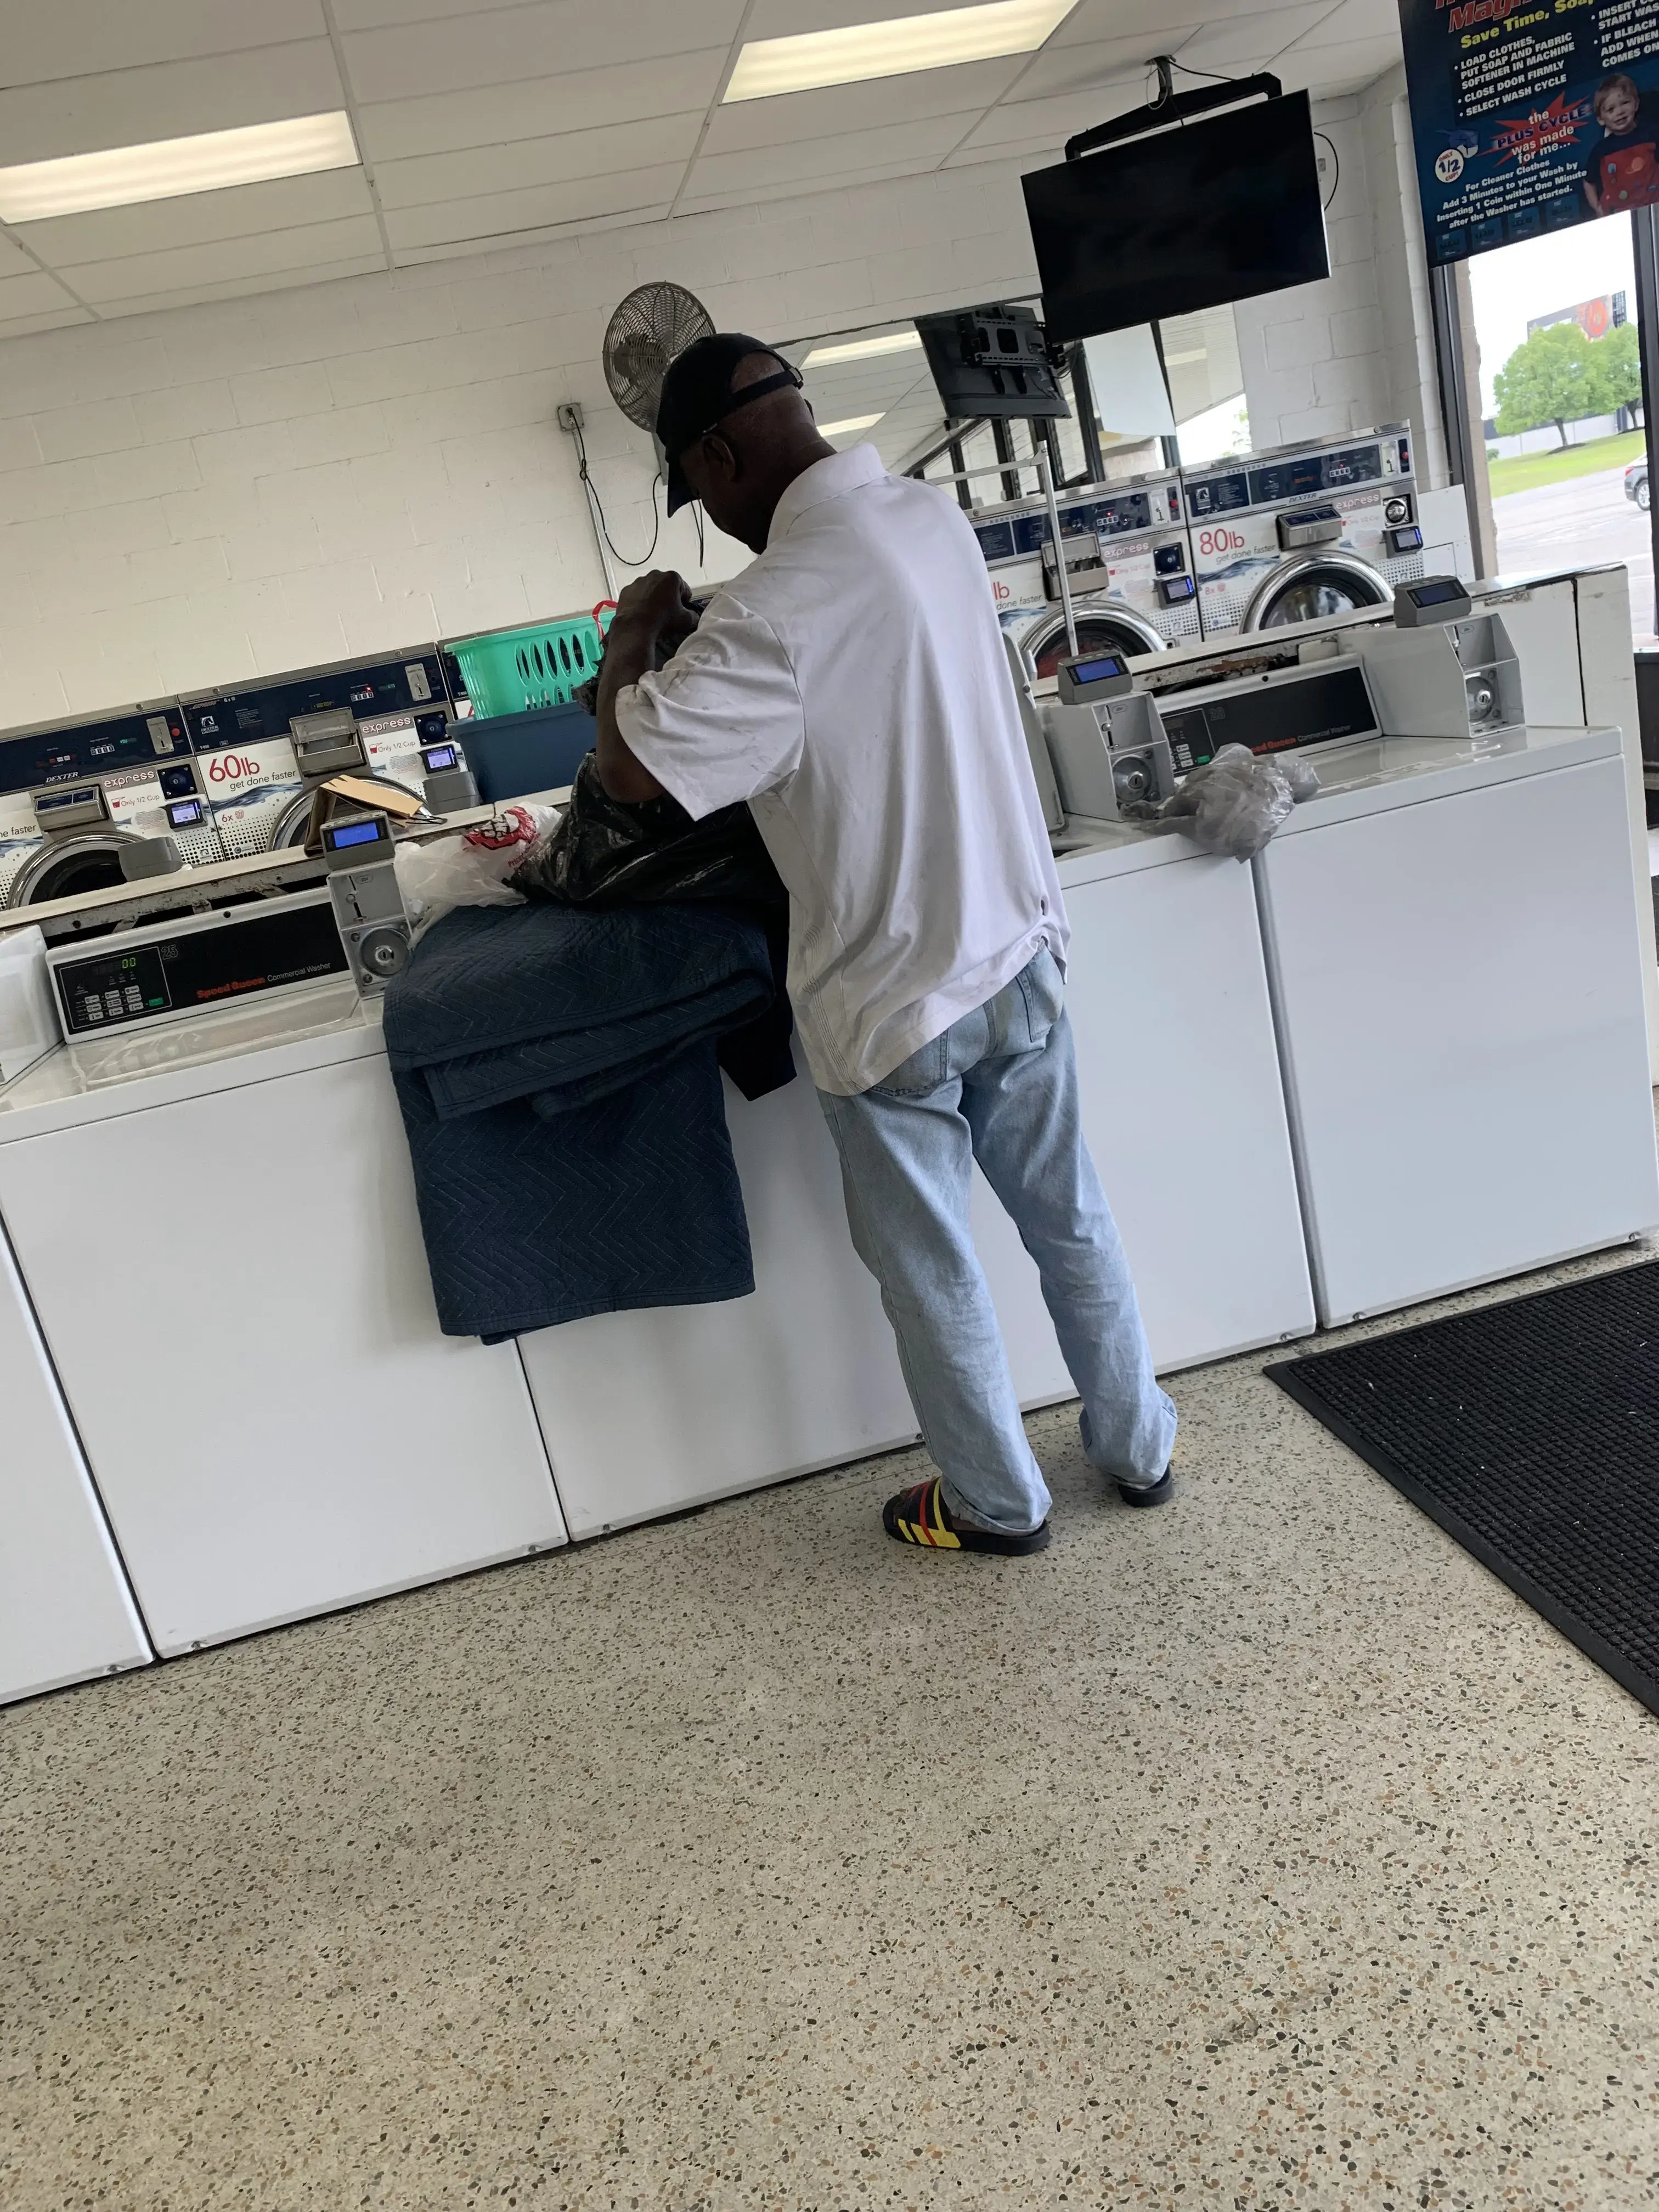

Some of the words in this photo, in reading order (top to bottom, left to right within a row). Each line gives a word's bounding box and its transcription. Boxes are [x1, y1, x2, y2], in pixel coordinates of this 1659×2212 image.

[1599, 0, 1636, 19] INSERT
[1599, 11, 1632, 30] START
[1634, 2, 1659, 18] WAS
[1460, 27, 1499, 48] Save
[1503, 9, 1550, 32] Time,
[1601, 33, 1611, 44] IF
[1614, 18, 1657, 40] BLEACH
[1460, 53, 1486, 70] LOAD
[1489, 36, 1536, 59] CLOTHES,
[1601, 42, 1624, 57] ADD
[1626, 29, 1659, 48] WHEN
[1602, 48, 1641, 67] COMES
[1644, 41, 1659, 54] ON
[1460, 66, 1479, 80] PUT
[1482, 55, 1508, 72] SOAP
[1510, 47, 1532, 61] AND
[1535, 32, 1572, 53] FABRIC
[1462, 65, 1510, 90] SOFTENER
[1513, 60, 1523, 71] IN
[1526, 42, 1575, 66] MACHINE
[1464, 85, 1495, 103] CLOSE
[1497, 75, 1525, 91] DOOR
[1527, 59, 1565, 80] FIRMLY
[1466, 97, 1500, 116] SELECT
[1502, 86, 1532, 103] WASH
[1534, 74, 1567, 92] CYCLE
[1497, 127, 1534, 149] PLUS
[1539, 107, 1587, 132] CYCLE
[1528, 111, 1549, 125] the
[1511, 140, 1536, 155] was
[1540, 126, 1574, 145] made
[1439, 151, 1453, 162] ONLY
[1518, 150, 1536, 164] for
[1539, 142, 1571, 156] me...
[1438, 159, 1460, 173] 1/2
[1465, 183, 1479, 192] For
[1481, 172, 1514, 187] Cleaner
[1516, 160, 1550, 176] Clothes
[1437, 206, 1474, 222] Inserting
[1483, 196, 1503, 207] Coin
[1505, 187, 1532, 201] within
[1534, 182, 1552, 191] One
[1555, 170, 1587, 186] Minute
[1443, 196, 1459, 210] Add
[1462, 195, 1468, 204] 3
[1469, 185, 1504, 202] Minutes
[1506, 182, 1515, 190] to
[1517, 174, 1537, 188] your
[1540, 166, 1564, 179] Wash
[1566, 161, 1578, 173] by
[1449, 218, 1469, 229] after
[1470, 213, 1484, 222] the
[1486, 202, 1518, 217] Washer
[1520, 197, 1536, 207] has
[1538, 184, 1573, 201] started.
[1289, 493, 1317, 503] DEXTER
[1336, 494, 1379, 510] express
[1104, 542, 1149, 558] express
[1199, 528, 1245, 555] 80lb
[1216, 554, 1229, 565] get
[1231, 547, 1251, 560] done
[1254, 544, 1276, 555] faster
[992, 582, 1010, 600] lb
[1019, 594, 1043, 605] faster
[362, 716, 411, 734] express
[403, 741, 415, 749] Cup
[1267, 737, 1296, 749] Queen
[1297, 729, 1330, 742] Commercial
[45, 771, 79, 784] DEXTER
[103, 770, 156, 788] express
[209, 754, 260, 782] 60lb
[230, 781, 244, 792] get
[246, 775, 269, 787] done
[272, 770, 296, 781] faster
[121, 797, 136, 808] Only
[137, 795, 146, 804] 1/2
[147, 793, 160, 804] Cup
[222, 814, 234, 822] 6x
[11, 825, 36, 836] faster
[161, 944, 178, 960] 25
[196, 983, 231, 999] Speed
[231, 976, 266, 990] Queen
[267, 968, 307, 982] Commercial
[306, 962, 331, 973] Washer
